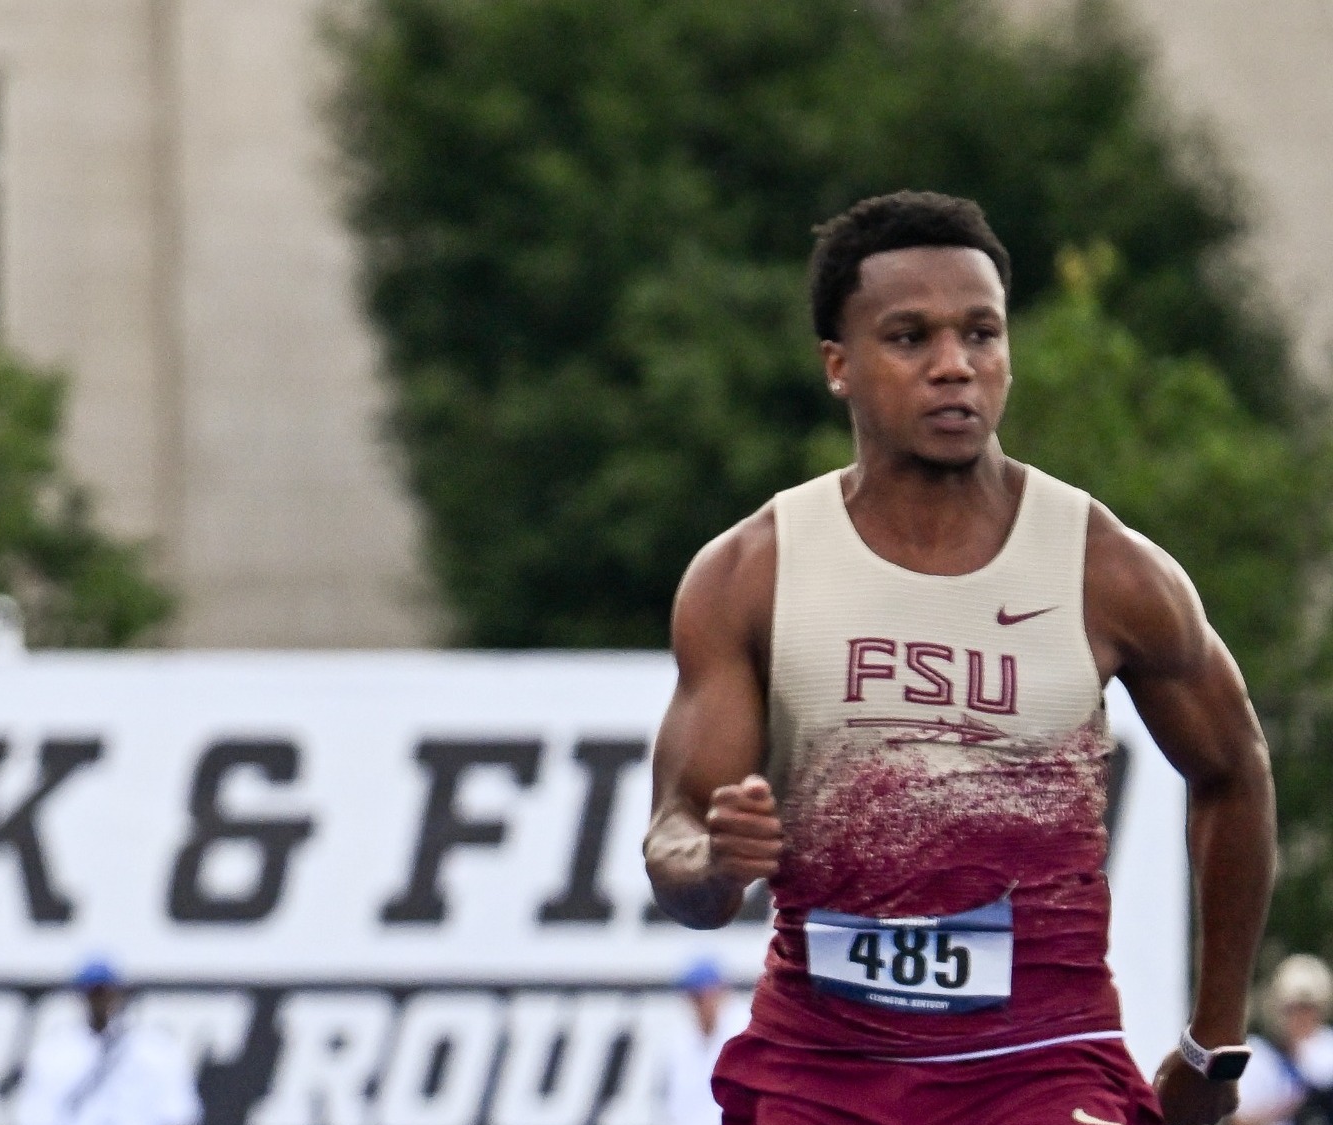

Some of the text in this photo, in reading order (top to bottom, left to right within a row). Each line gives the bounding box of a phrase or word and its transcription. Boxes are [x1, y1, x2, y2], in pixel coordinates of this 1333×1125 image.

[843, 636, 1020, 716] FSU
[166, 736, 320, 924] &
[849, 926, 971, 990] 485
